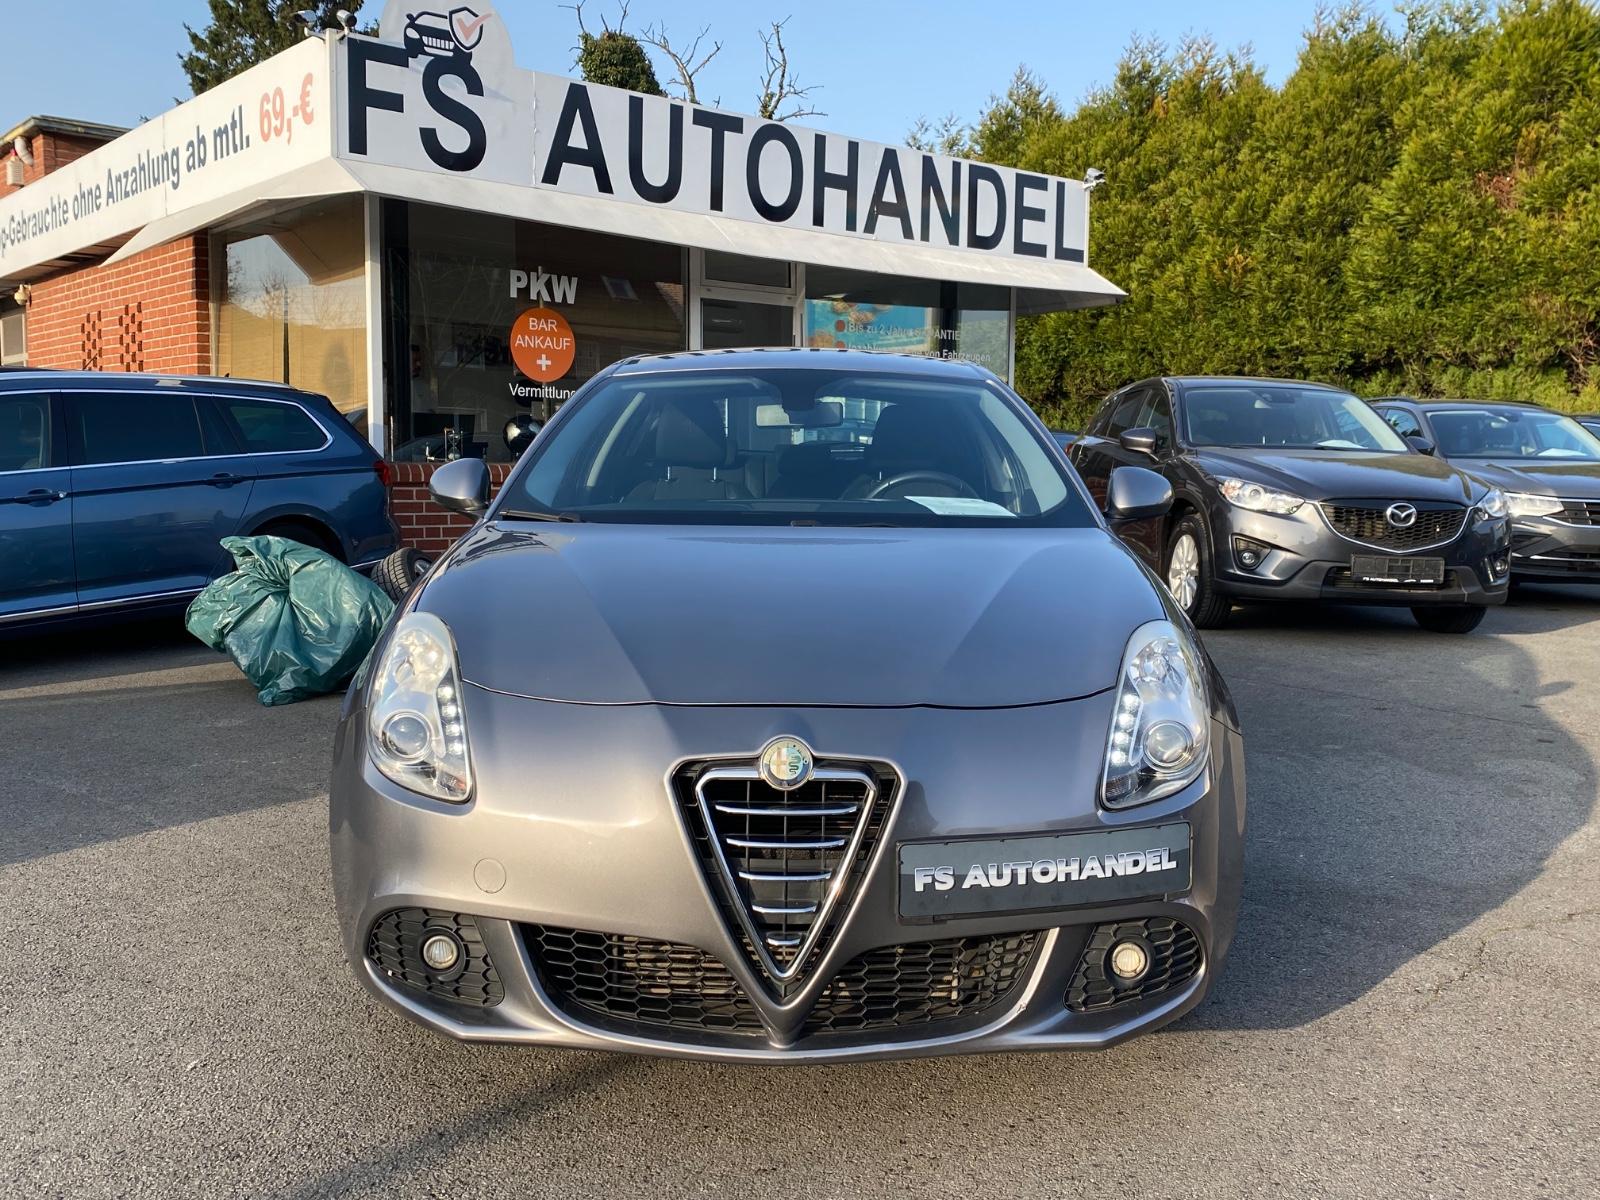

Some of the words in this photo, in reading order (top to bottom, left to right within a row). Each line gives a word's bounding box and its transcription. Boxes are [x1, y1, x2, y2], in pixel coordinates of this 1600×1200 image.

[0, 193, 69, 257] p-Gebrauchte
[73, 182, 102, 221] ohne
[106, 145, 180, 206] Anzahlung
[186, 125, 207, 173] ab
[213, 104, 250, 161] mtl.
[259, 72, 314, 146] 69,-€
[347, 37, 487, 172] FS
[541, 82, 1084, 263] AUTOHANDEL
[509, 269, 578, 305] PKW
[514, 335, 572, 351] ANKAUF
[528, 317, 558, 333] BAR
[942, 348, 991, 363] Fahrzeugen
[914, 865, 955, 892] FS
[961, 847, 1177, 889] AUTOHANDEL
